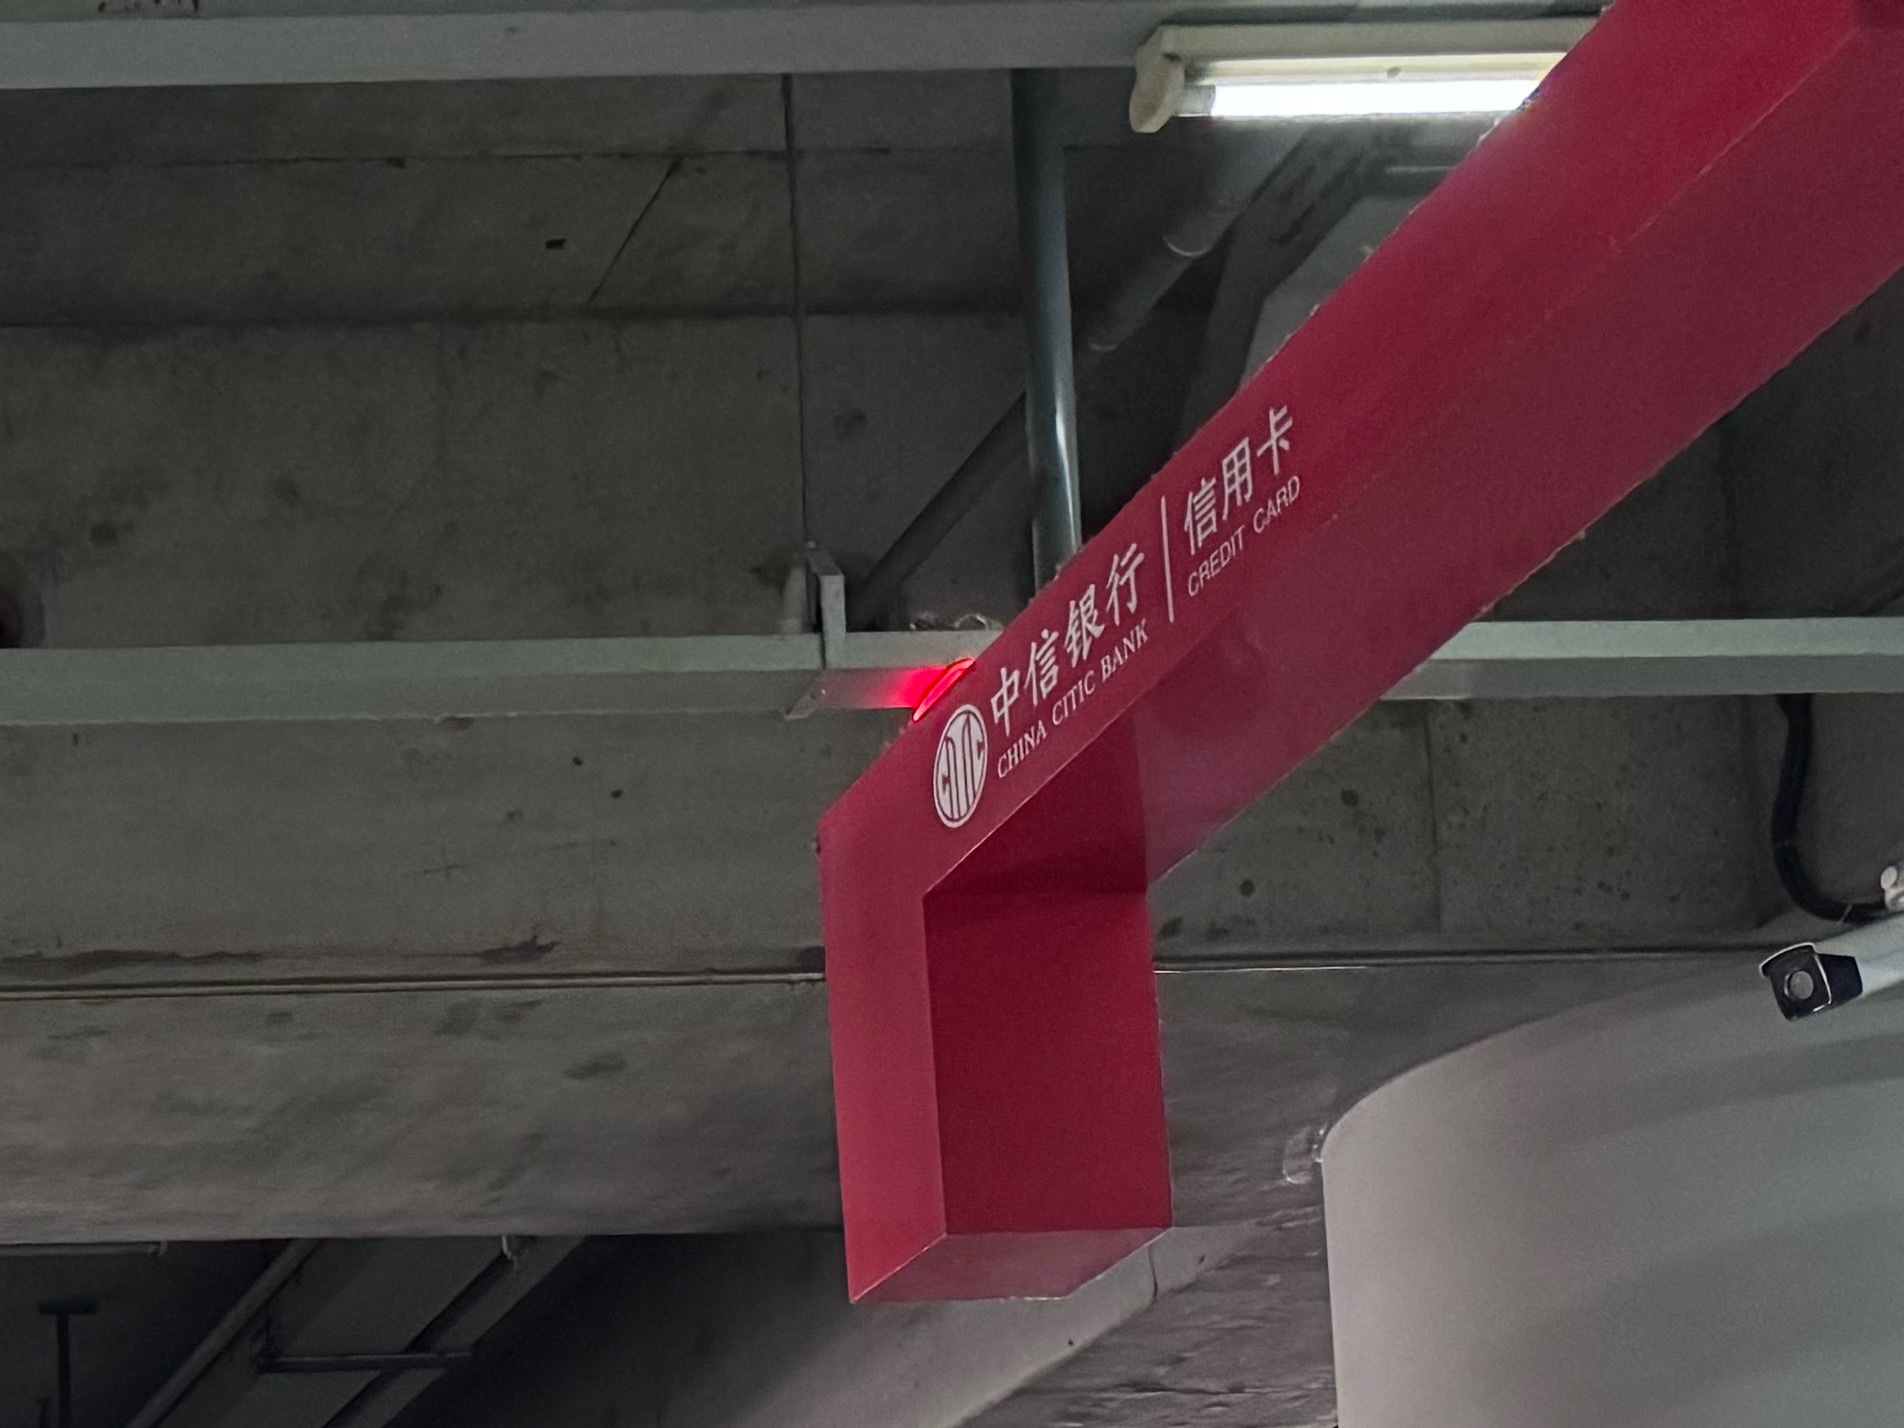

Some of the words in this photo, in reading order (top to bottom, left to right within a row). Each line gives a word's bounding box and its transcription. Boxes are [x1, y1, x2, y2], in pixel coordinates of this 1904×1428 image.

[1183, 404, 1295, 556] 信用卡
[1186, 528, 1246, 598] CREDIT
[1252, 473, 1302, 533] CARD
[990, 543, 1146, 738] 中信银行
[996, 724, 1048, 779] CHINA
[1051, 677, 1097, 727] CITIC
[1100, 619, 1149, 683] BANK
